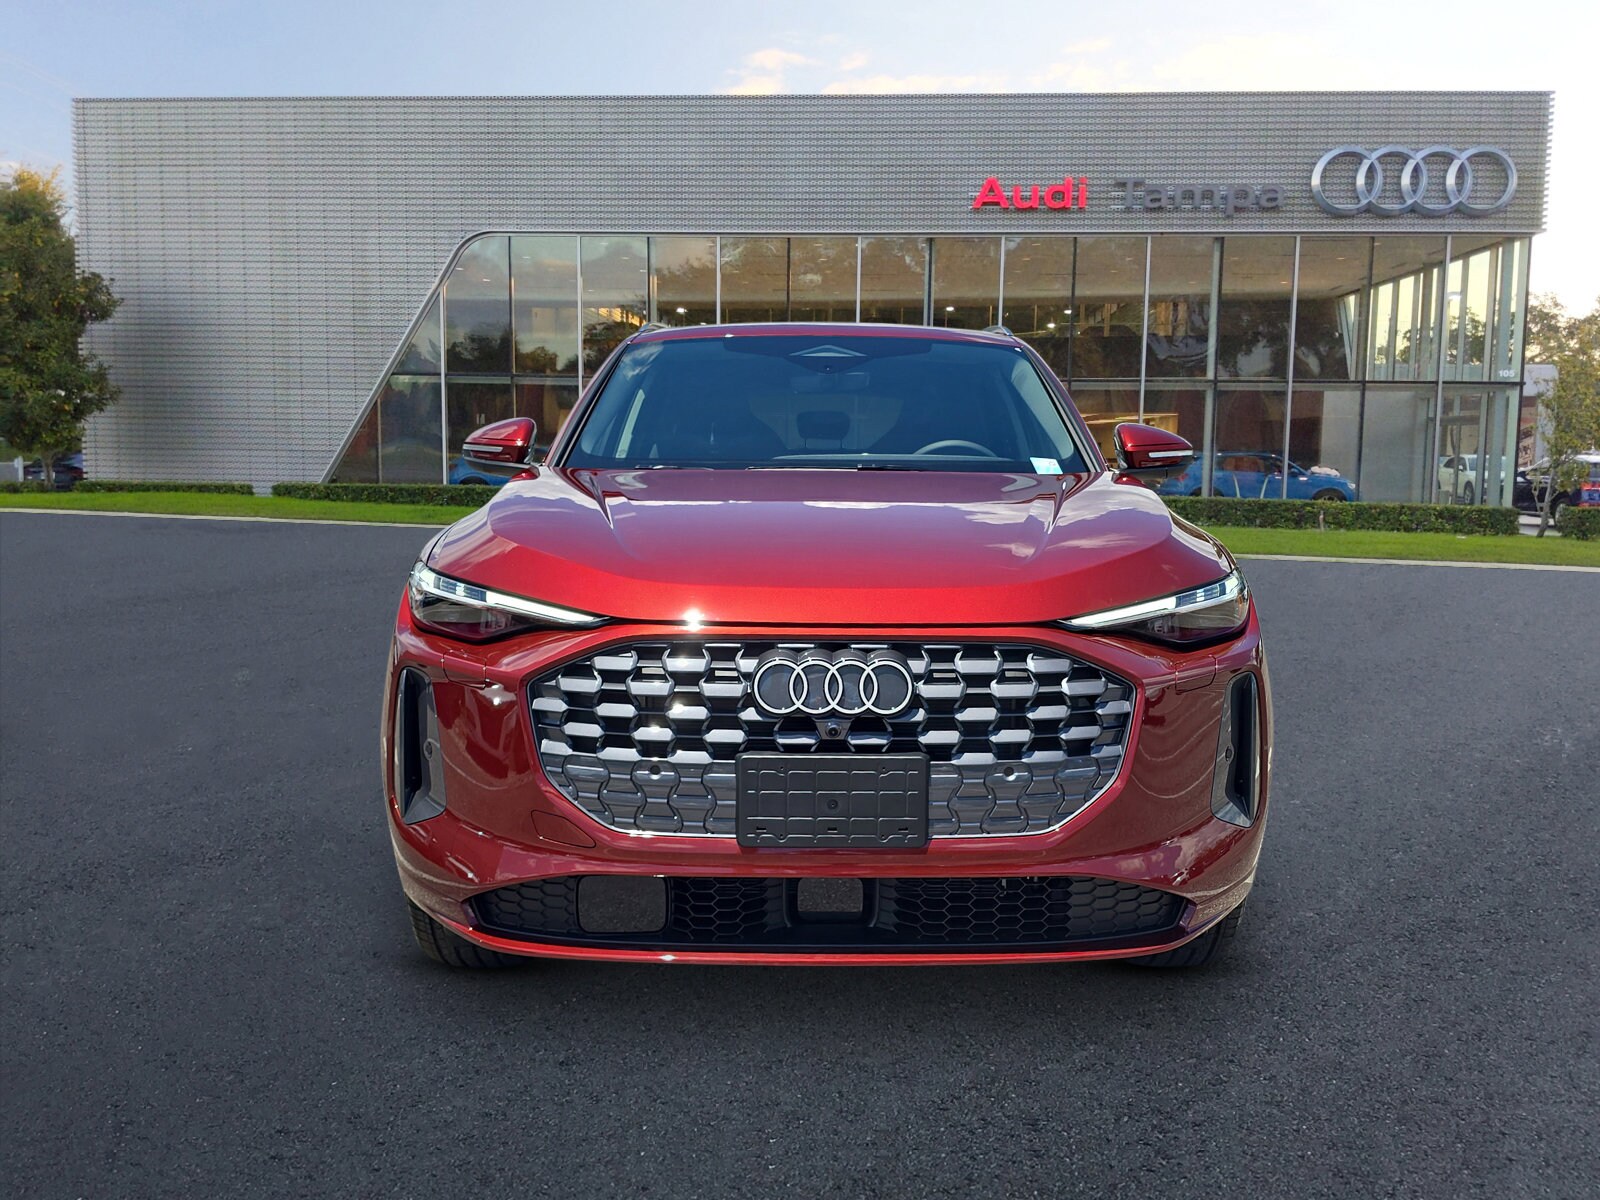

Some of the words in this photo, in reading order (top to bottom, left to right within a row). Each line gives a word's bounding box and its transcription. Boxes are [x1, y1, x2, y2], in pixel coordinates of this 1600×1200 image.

[972, 177, 1088, 210] Audi
[1115, 178, 1286, 217] Tampa
[1499, 369, 1515, 378] 105
